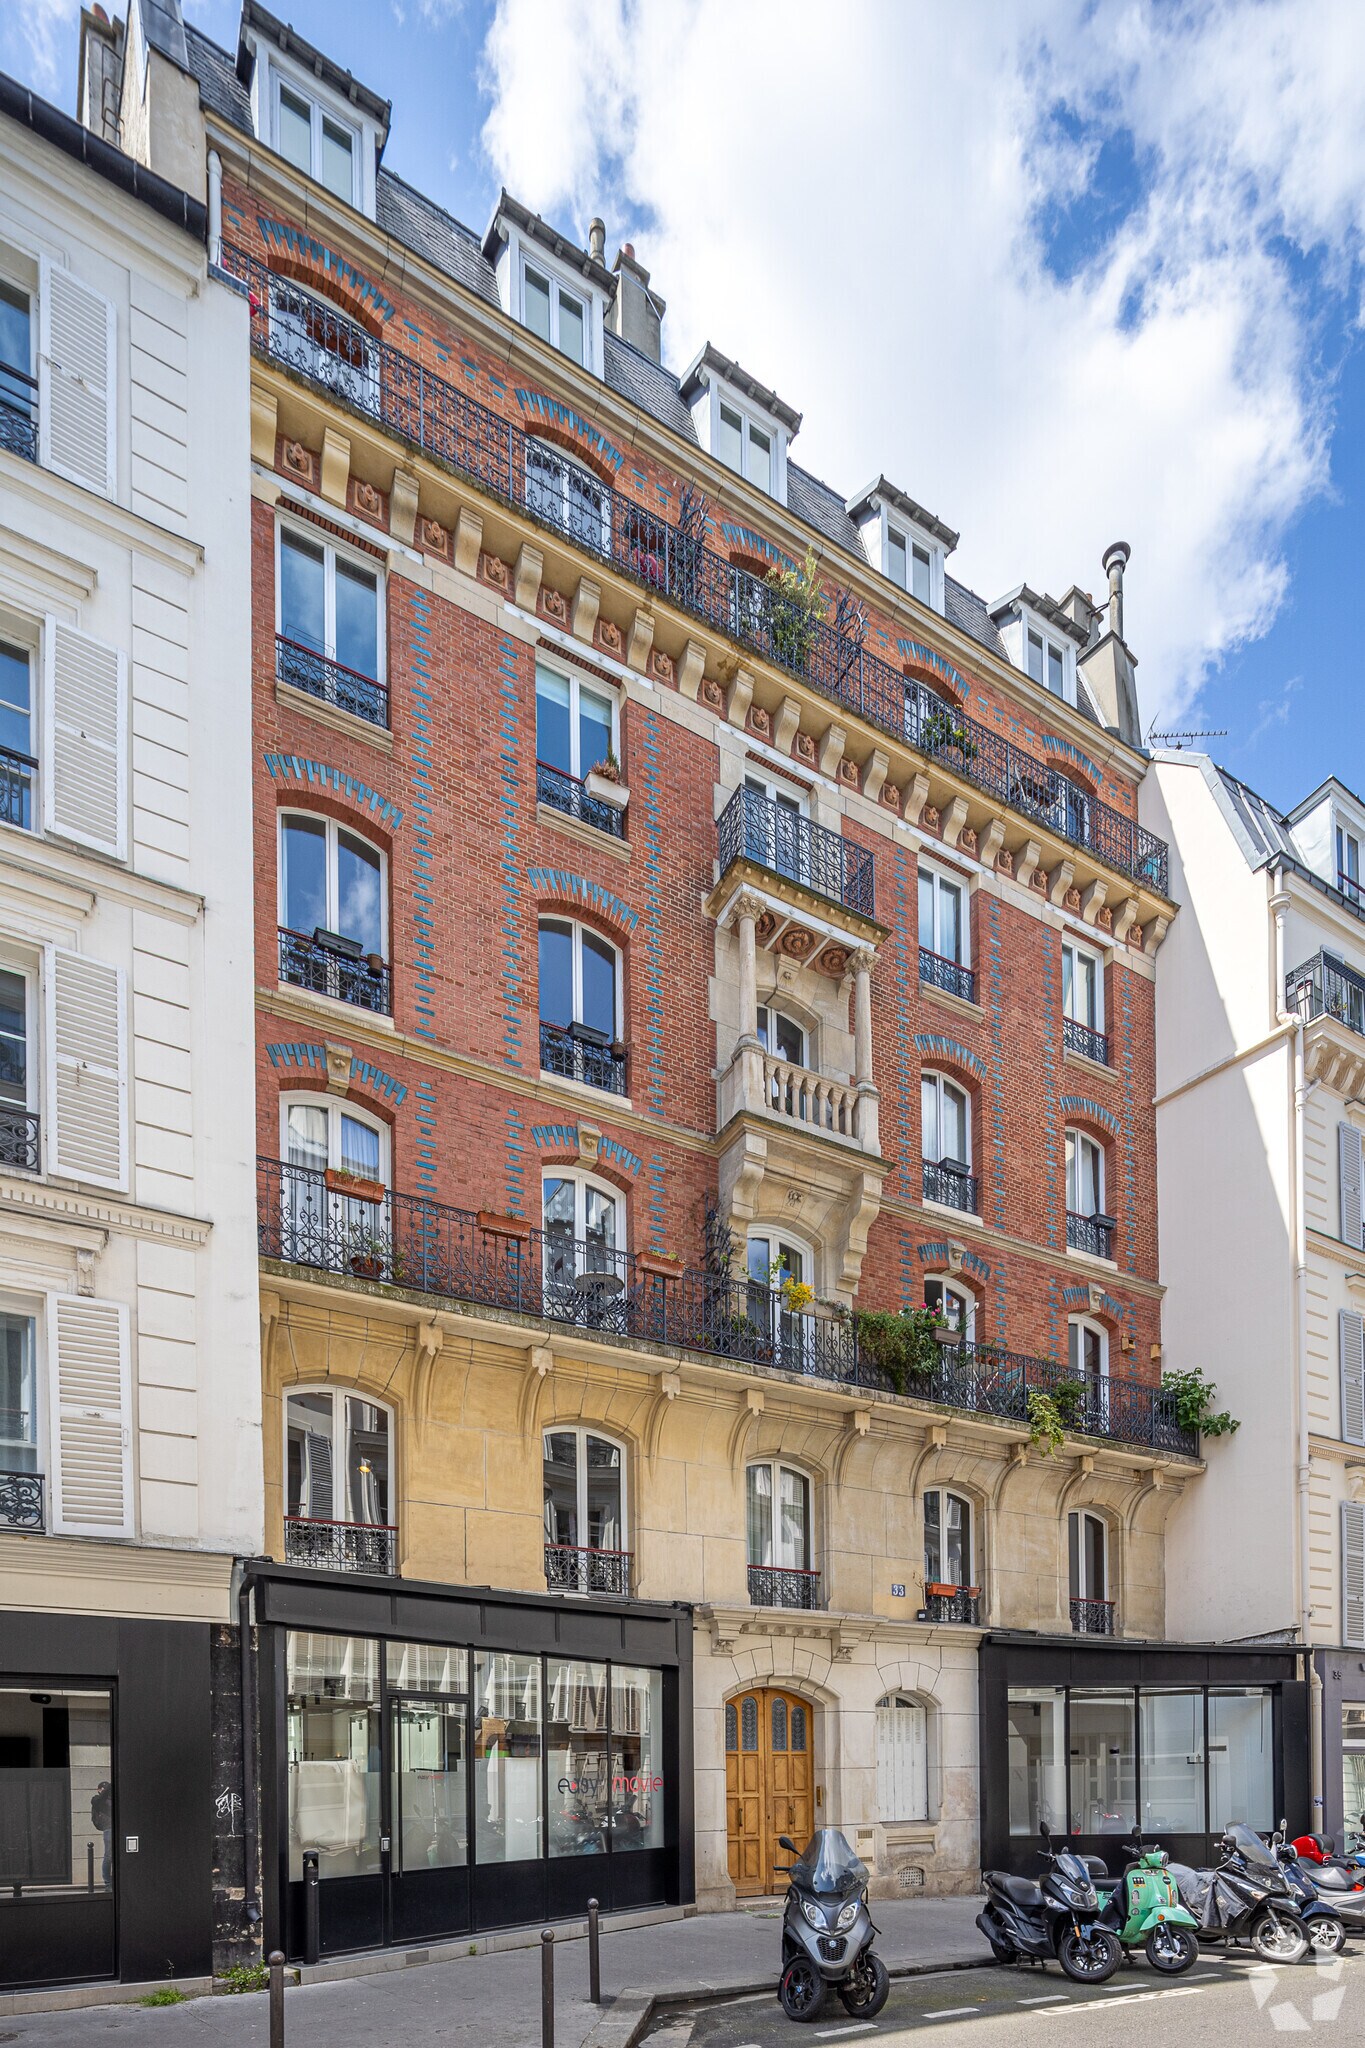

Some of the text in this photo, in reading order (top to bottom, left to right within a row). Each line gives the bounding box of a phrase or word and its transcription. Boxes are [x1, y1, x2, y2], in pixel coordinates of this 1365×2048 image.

[893, 1585, 904, 1596] 33
[1332, 1670, 1342, 1680] 35
[612, 1771, 664, 1793] movie
